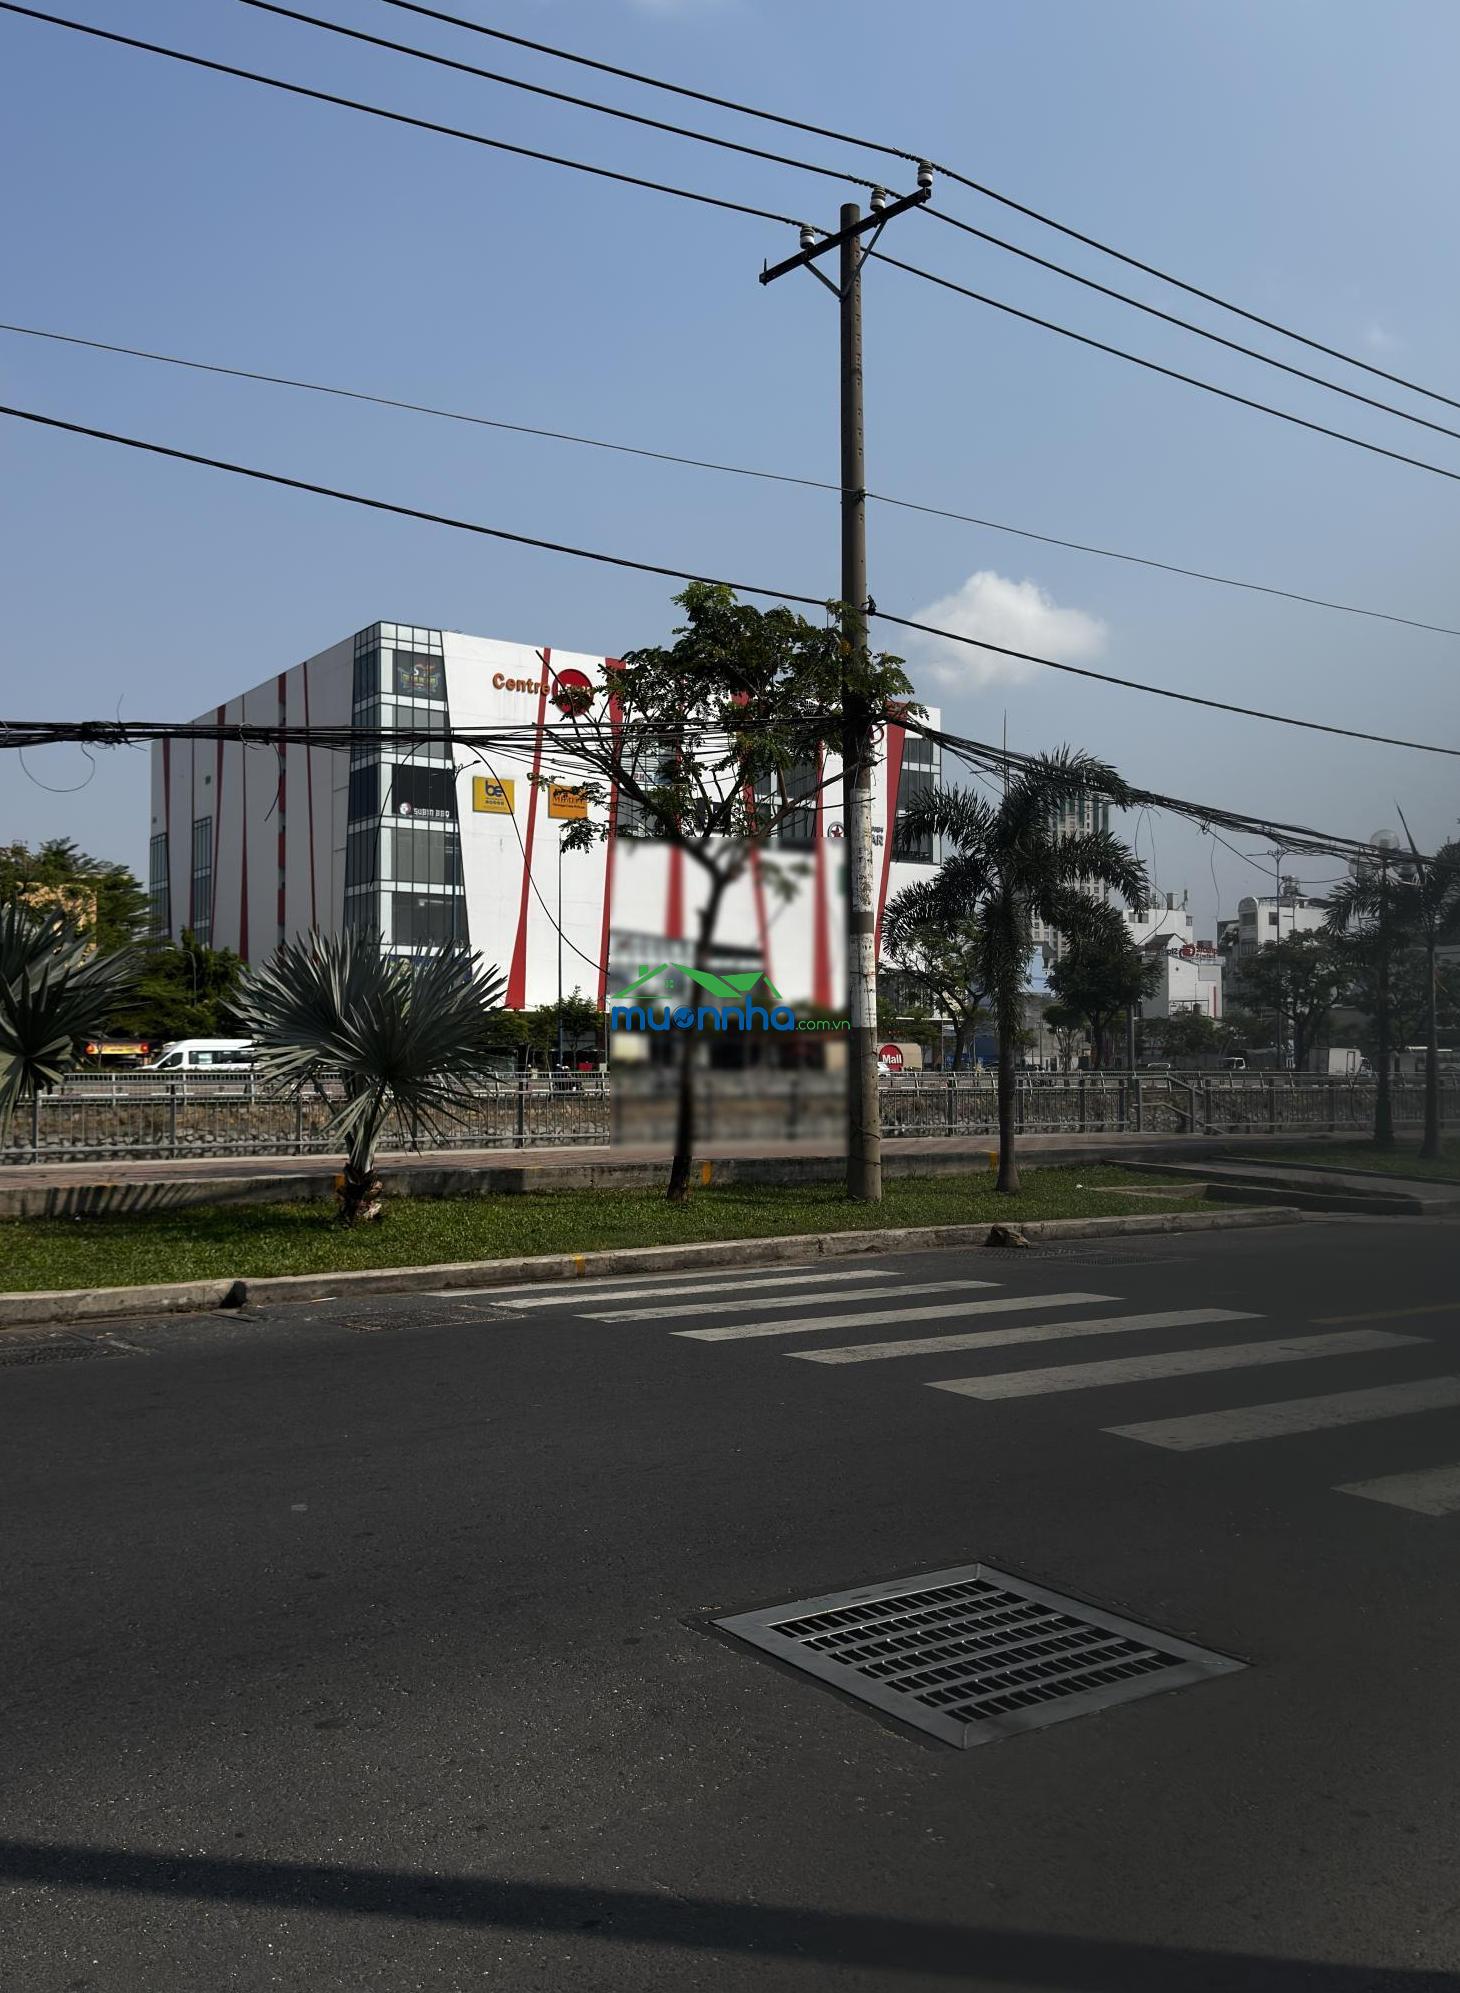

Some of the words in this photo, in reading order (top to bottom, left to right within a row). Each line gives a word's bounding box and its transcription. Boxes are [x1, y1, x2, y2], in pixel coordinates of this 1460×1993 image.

[492, 672, 551, 697] Centre
[485, 780, 504, 798] be
[882, 1054, 902, 1064] Mall
